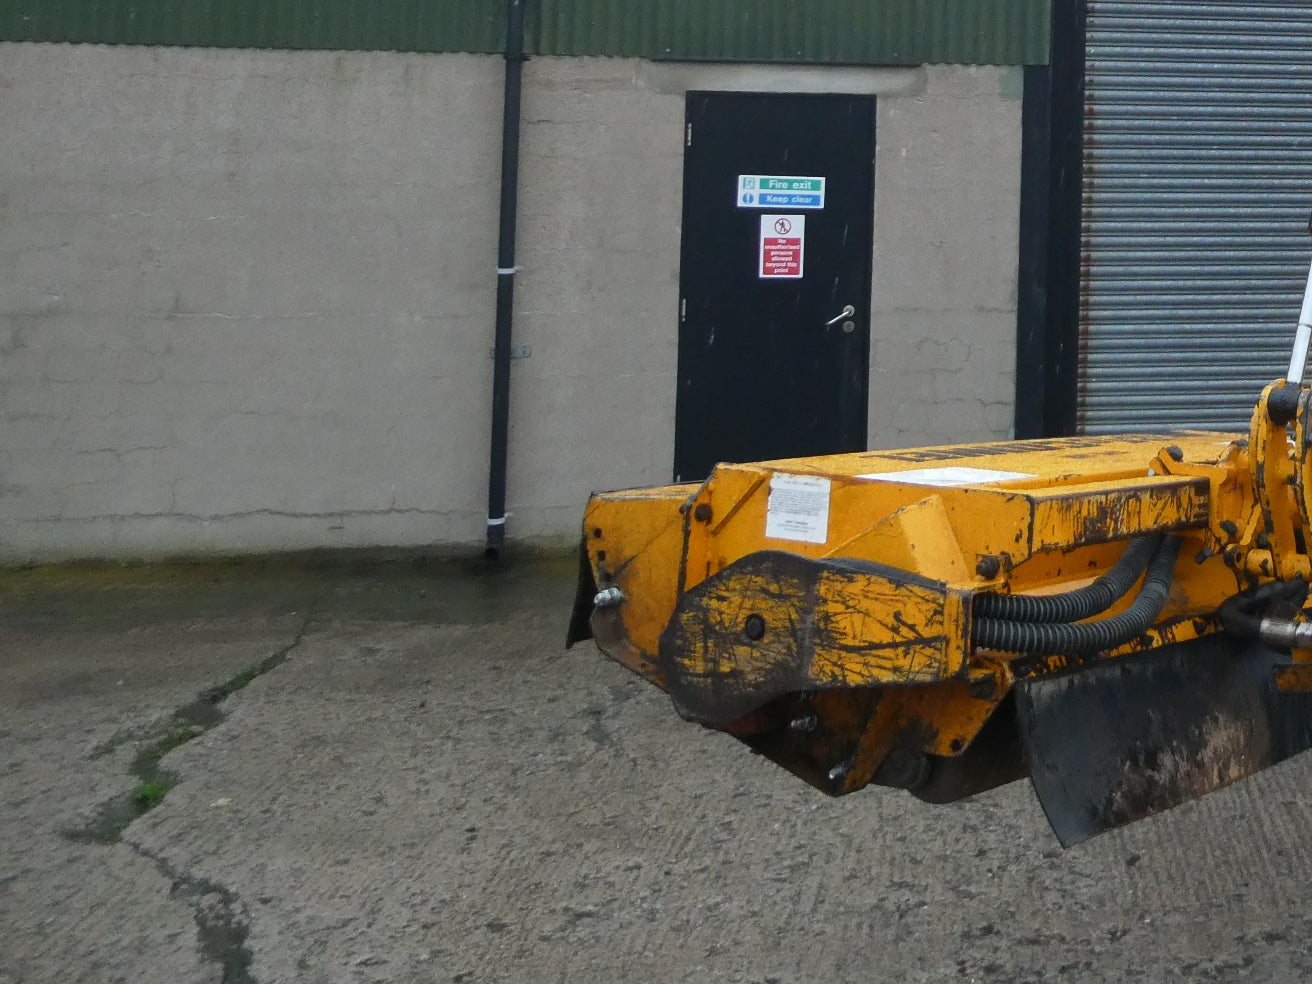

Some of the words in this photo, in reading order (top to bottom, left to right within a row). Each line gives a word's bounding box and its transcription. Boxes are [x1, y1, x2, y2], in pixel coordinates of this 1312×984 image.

[769, 179, 788, 189] Fire
[792, 180, 812, 190] exit
[766, 195, 789, 204] Keep
[791, 195, 813, 204] clear
